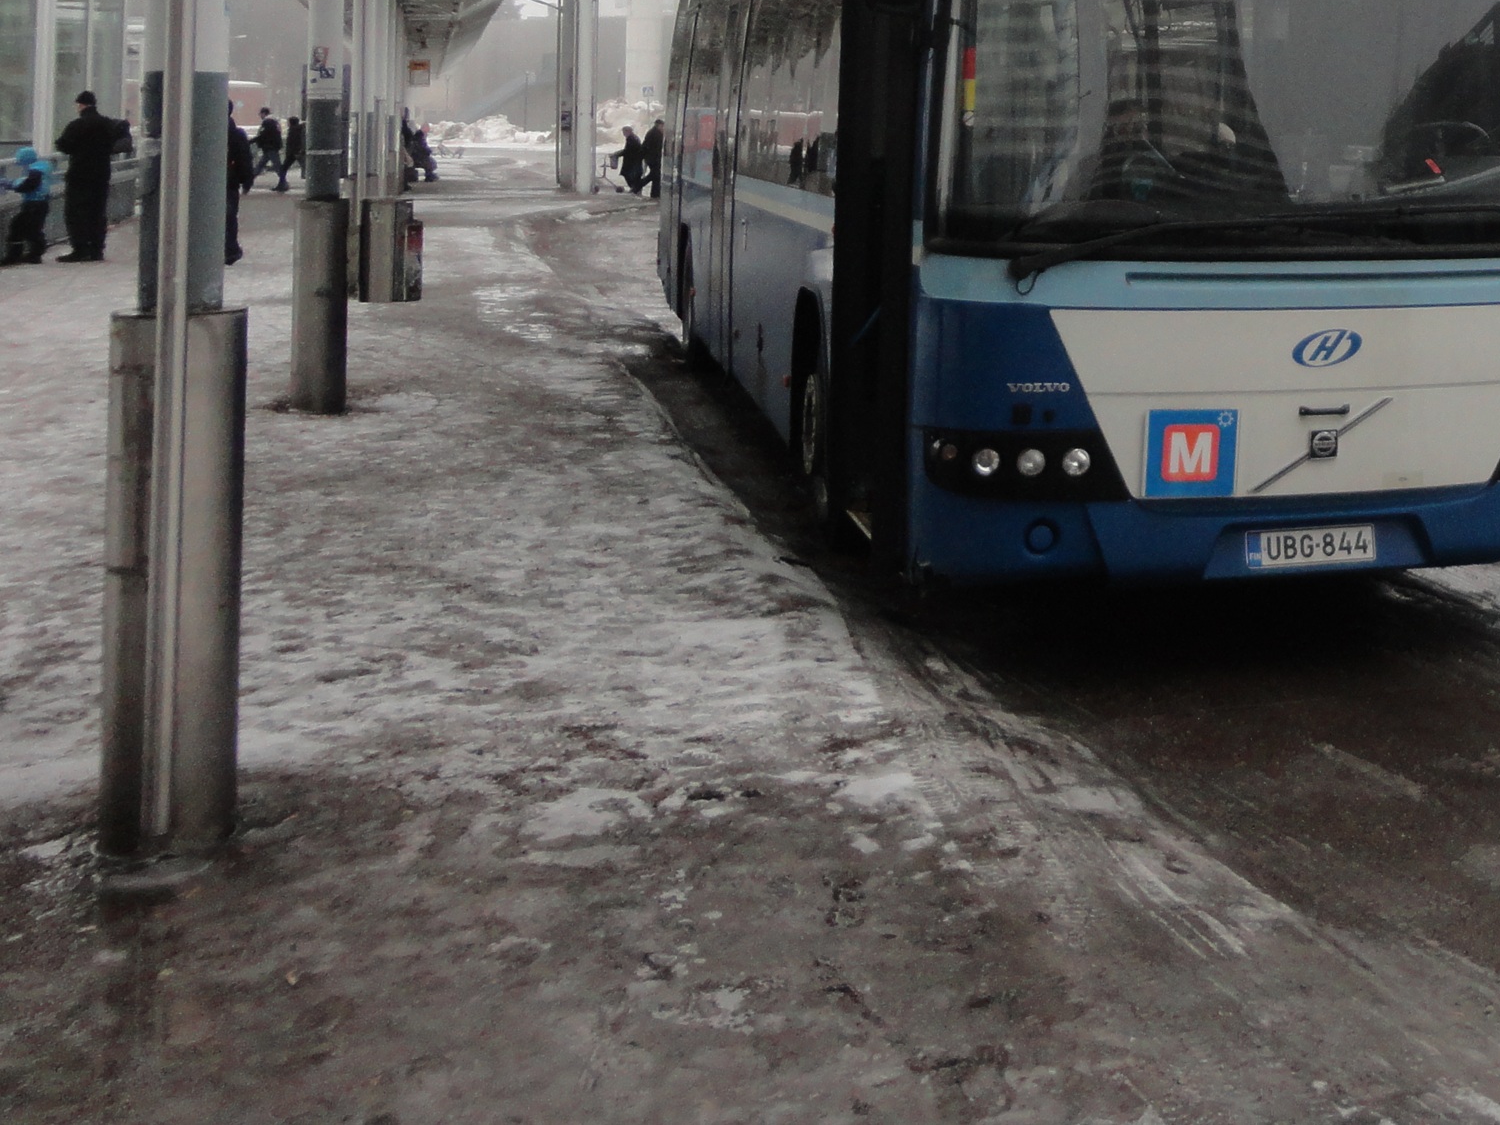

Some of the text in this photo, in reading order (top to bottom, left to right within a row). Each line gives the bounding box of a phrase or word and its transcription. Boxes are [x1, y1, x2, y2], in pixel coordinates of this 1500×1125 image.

[1006, 382, 1070, 393] VOLVO
[1168, 431, 1213, 475] M
[1266, 530, 1368, 560] UBG-844
